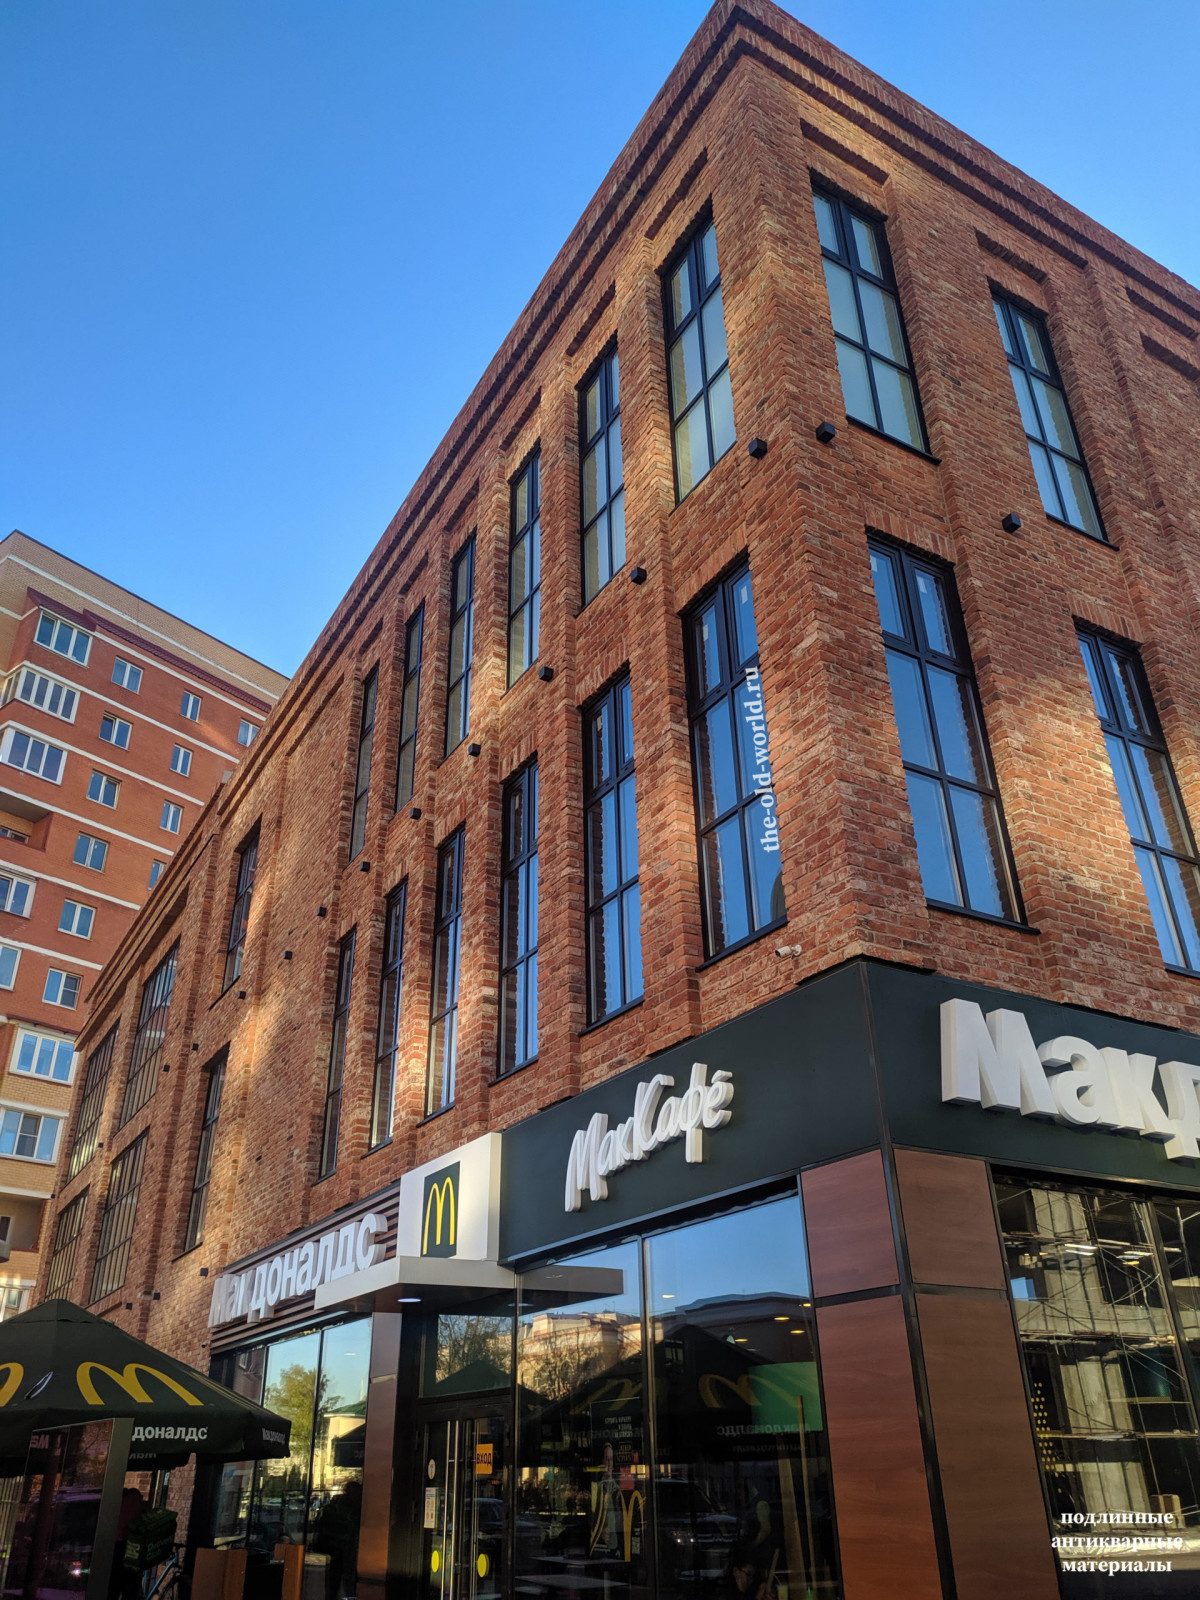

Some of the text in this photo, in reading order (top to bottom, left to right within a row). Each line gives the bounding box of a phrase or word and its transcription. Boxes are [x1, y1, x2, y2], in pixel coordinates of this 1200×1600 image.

[208, 1213, 388, 1328] Макдоналдс
[131, 1426, 208, 1442] доналдс
[476, 1453, 492, 1467] ВХОД
